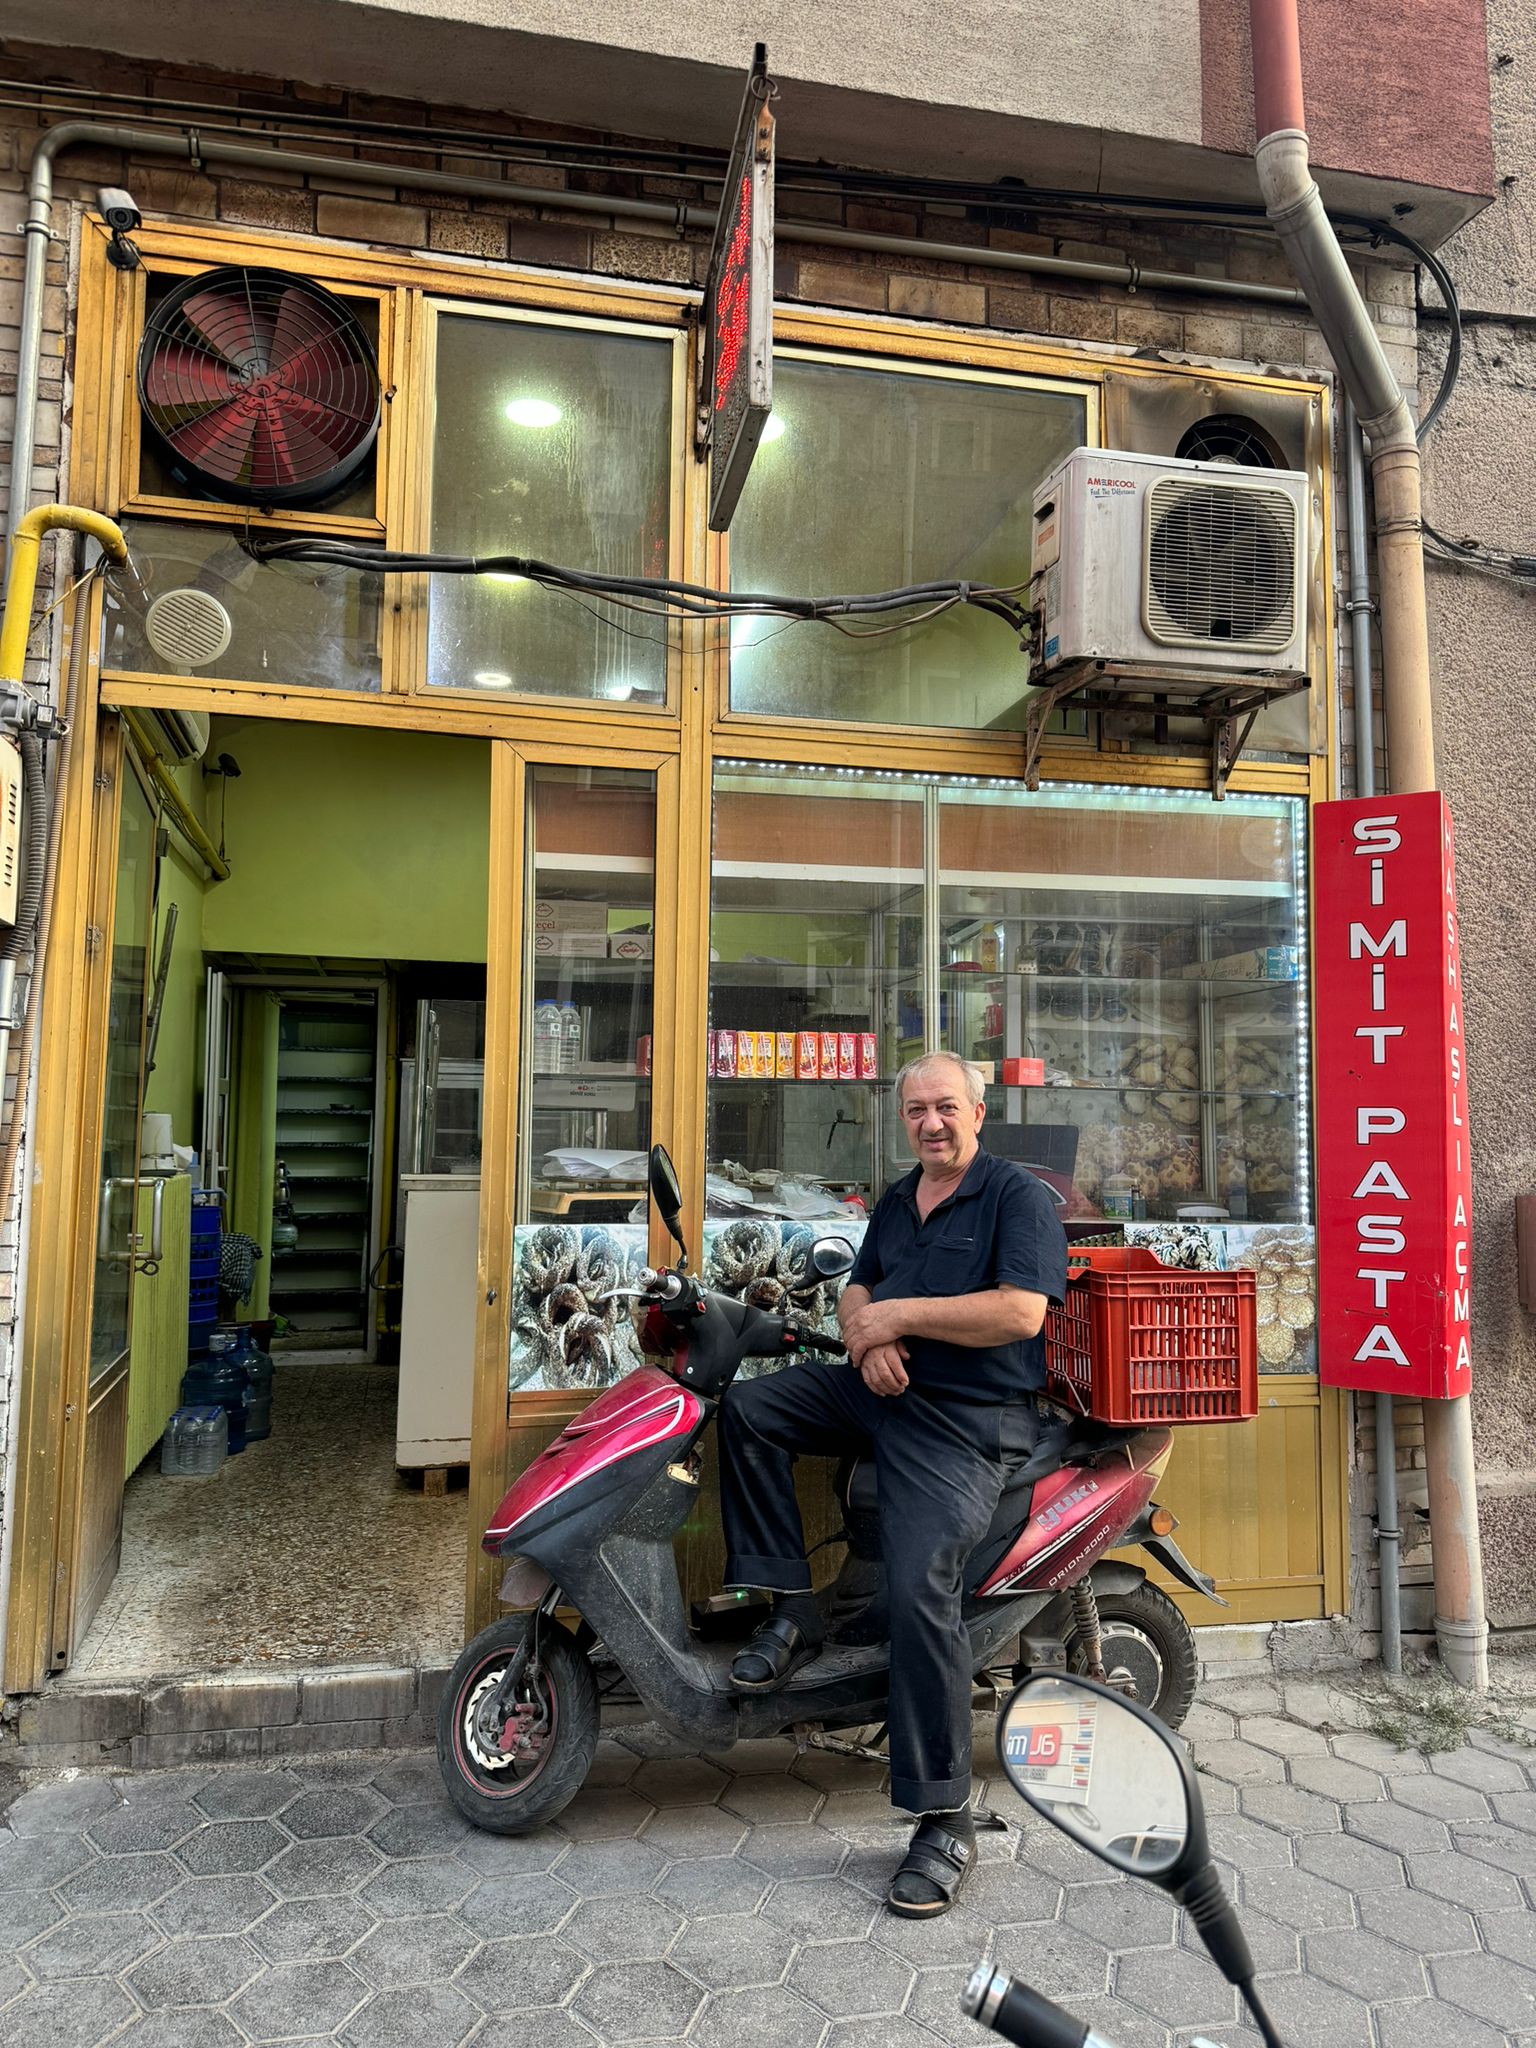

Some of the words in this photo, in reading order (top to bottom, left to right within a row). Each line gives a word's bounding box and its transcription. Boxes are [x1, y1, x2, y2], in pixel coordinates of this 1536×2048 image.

[1087, 477, 1136, 489] AMERICOOL
[536, 921, 556, 931] eçel
[1348, 815, 1408, 1065] SİMİT
[1351, 1106, 1412, 1367] PASTA
[1453, 1194, 1470, 1371] AÇMA
